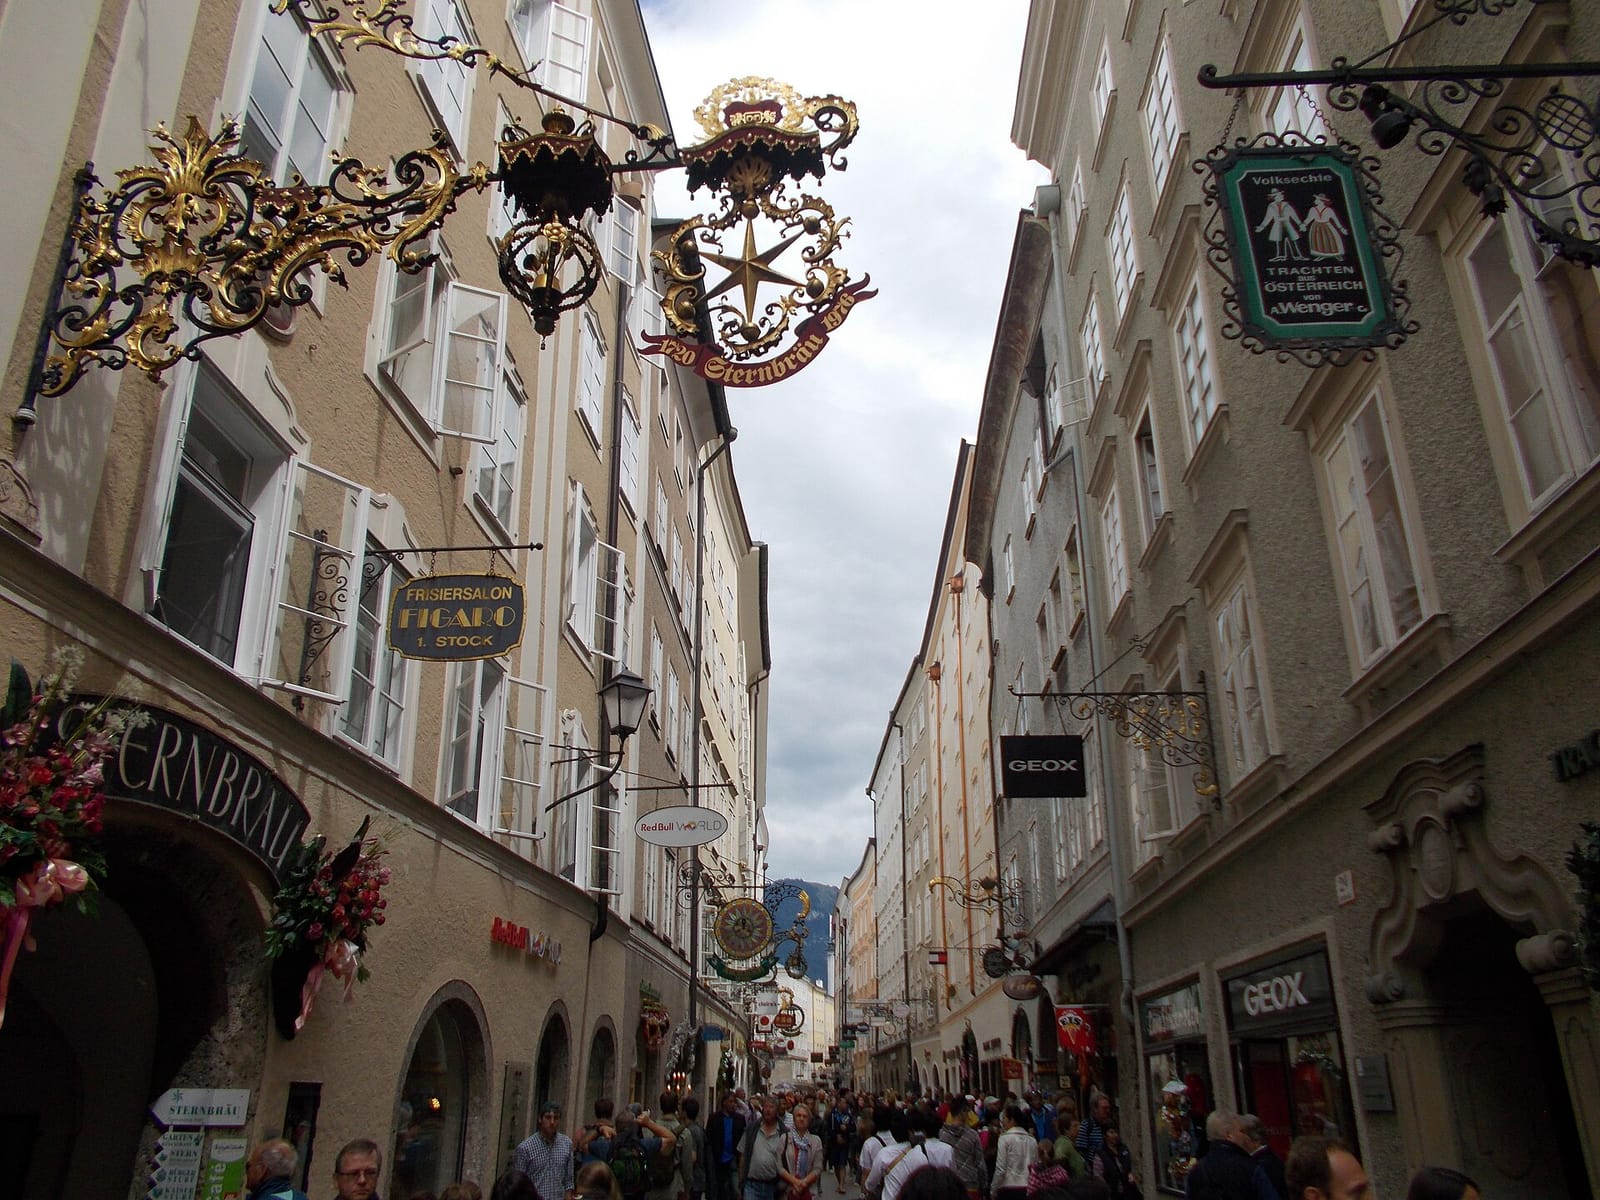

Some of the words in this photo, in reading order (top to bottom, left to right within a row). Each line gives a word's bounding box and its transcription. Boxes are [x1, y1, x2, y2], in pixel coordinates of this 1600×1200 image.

[1252, 173, 1333, 186] Volksechte
[1265, 265, 1355, 276] TRACHTEN
[1264, 280, 1364, 293] ÖSTERREICH
[658, 337, 697, 366] 1720
[703, 333, 824, 385] Sternbräu
[405, 586, 513, 601] FRISIERSALON
[398, 606, 516, 629] FIGARO
[416, 636, 427, 648] 1.
[435, 634, 494, 648] STOCK
[1008, 759, 1079, 772] GEOX
[57, 703, 303, 869] ERNBRÄU
[1243, 971, 1310, 1017] GEOX
[169, 1103, 241, 1116] STERNBRÄU
